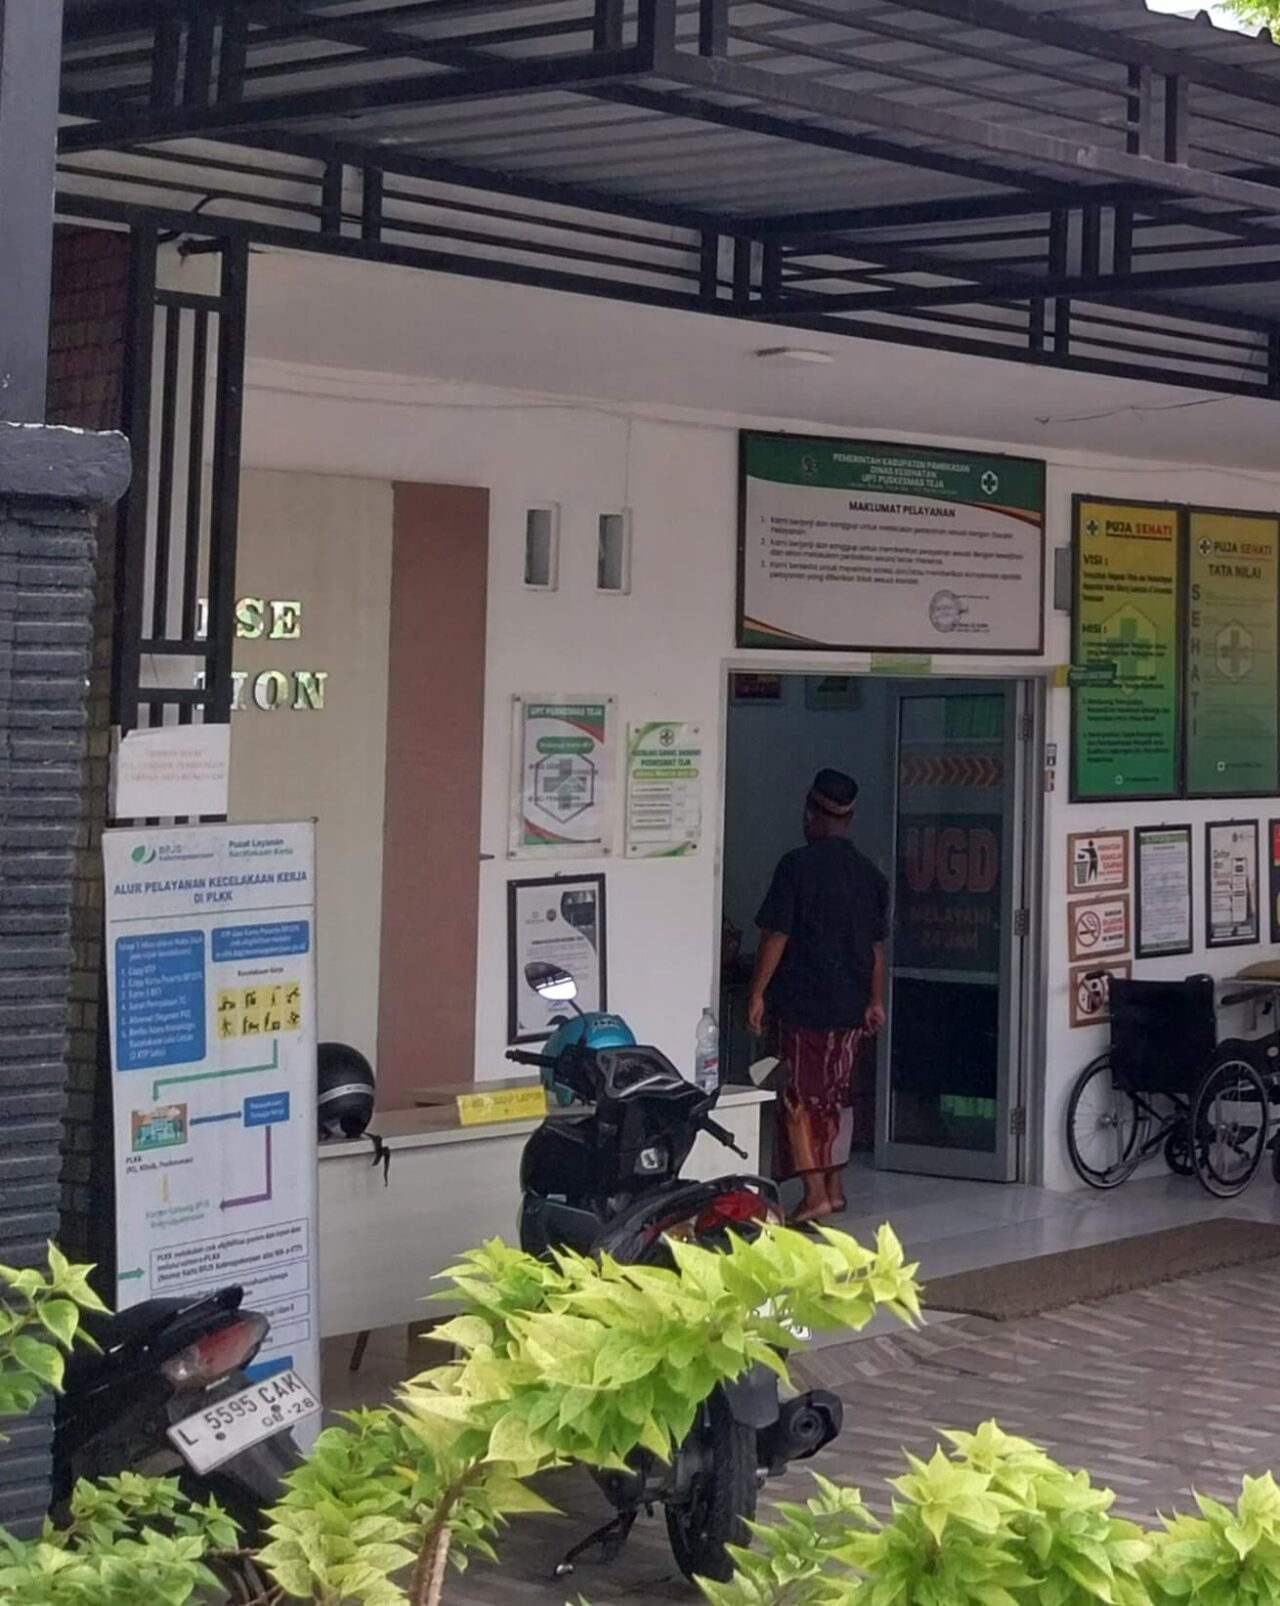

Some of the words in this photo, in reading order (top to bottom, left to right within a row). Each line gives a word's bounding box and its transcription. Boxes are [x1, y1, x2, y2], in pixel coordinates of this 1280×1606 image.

[849, 501, 901, 514] MAKLUMAT
[902, 505, 955, 518] PELAYANAN
[1106, 520, 1132, 533] PUJA
[1135, 523, 1172, 536] SEHATI
[1214, 541, 1237, 553] PUJA
[1083, 554, 1102, 565] VISI
[1208, 564, 1232, 577] TATA
[1235, 566, 1261, 579] NILAI
[905, 828, 998, 893] UGD
[114, 883, 142, 896] ALUR
[144, 879, 206, 893] PELAYANAN
[209, 873, 275, 888] KECELAKAAN
[277, 871, 308, 883] KERJA
[194, 894, 203, 904] DI
[206, 891, 233, 903] PLKK
[178, 1429, 199, 1446] L
[204, 1395, 258, 1430] 5595
[258, 1373, 301, 1404] CAK
